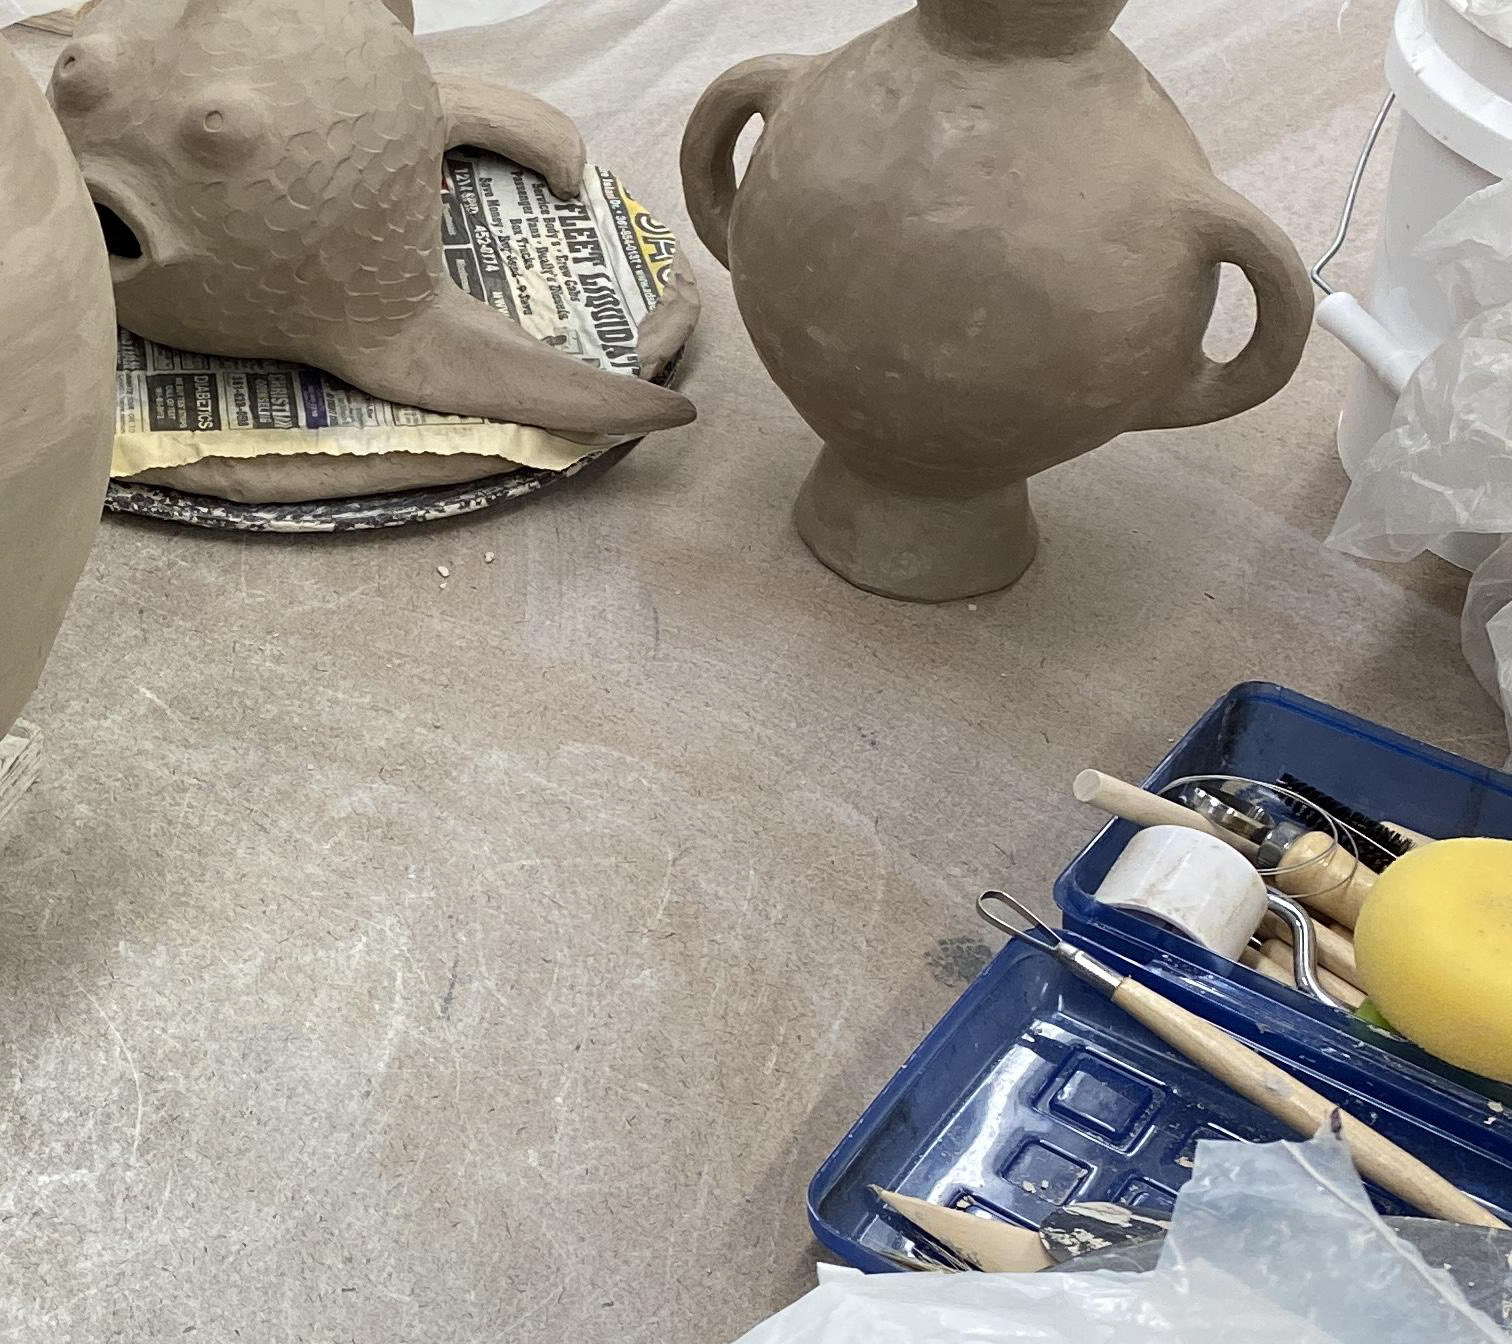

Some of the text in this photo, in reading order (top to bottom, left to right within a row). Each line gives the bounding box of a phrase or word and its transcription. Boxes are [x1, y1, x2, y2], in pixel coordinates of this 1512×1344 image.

[478, 177, 495, 197] Save
[486, 199, 503, 228] Money
[510, 171, 534, 215] Passenger
[526, 216, 541, 239] Vans
[510, 218, 536, 270] Box Trucks
[532, 183, 550, 215] Service
[556, 254, 571, 278] Crew
[554, 204, 607, 268] FLEET
[193, 376, 214, 429] DIABETICS
